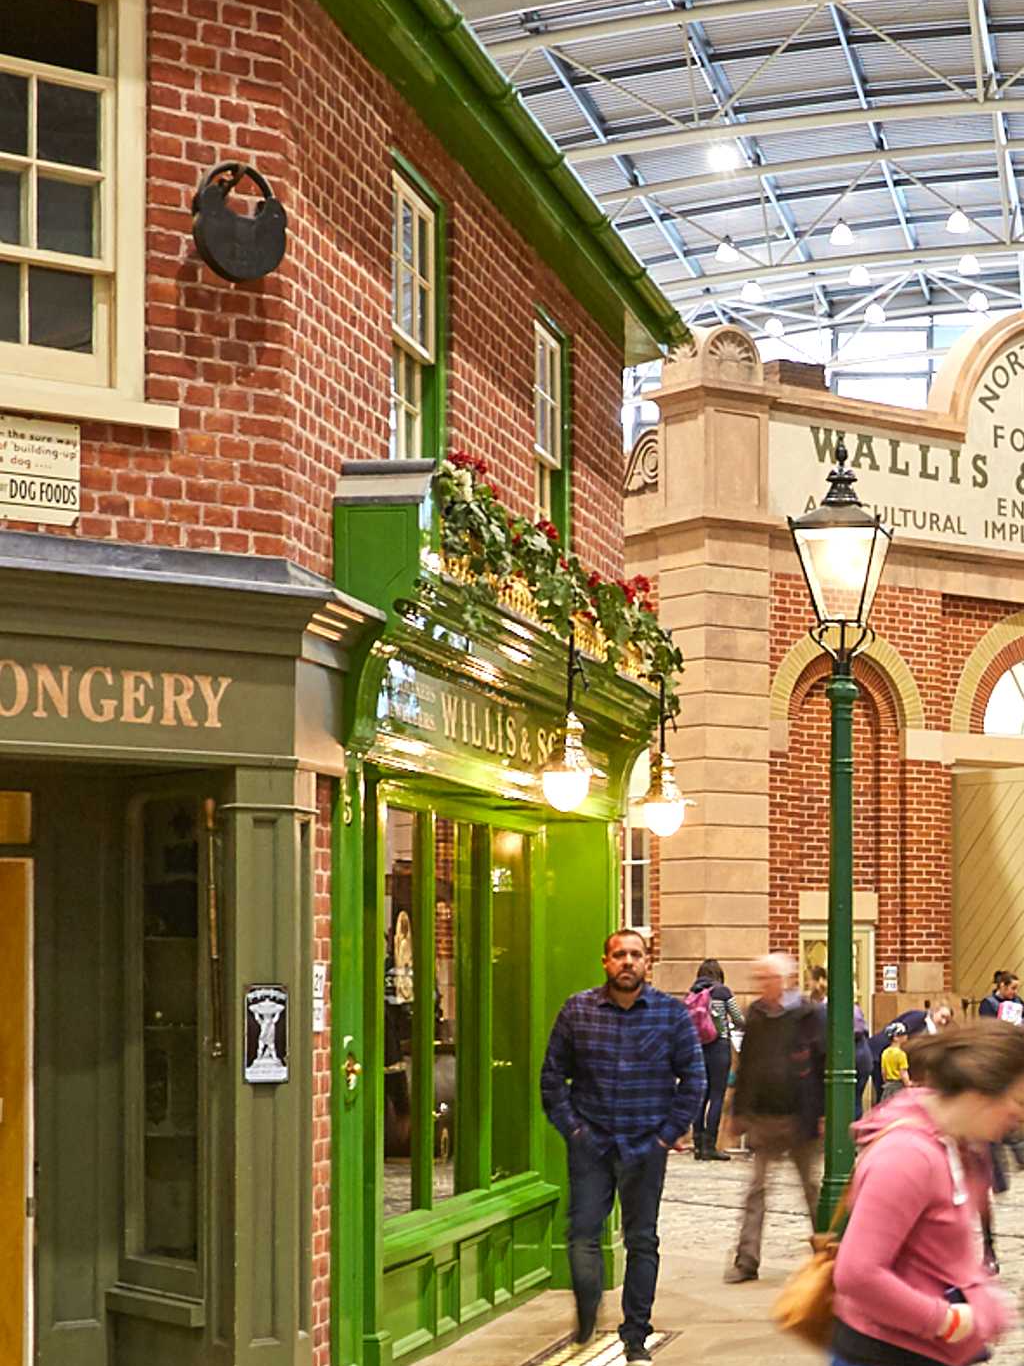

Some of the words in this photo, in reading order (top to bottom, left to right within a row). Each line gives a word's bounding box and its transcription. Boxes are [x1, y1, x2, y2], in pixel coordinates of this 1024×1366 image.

[810, 426, 988, 488] WALLIS
[10, 478, 36, 501] DOG
[40, 481, 77, 506] FOODS
[0, 659, 232, 728] ONGERY
[442, 693, 516, 756] WILLIS
[521, 727, 532, 763] &
